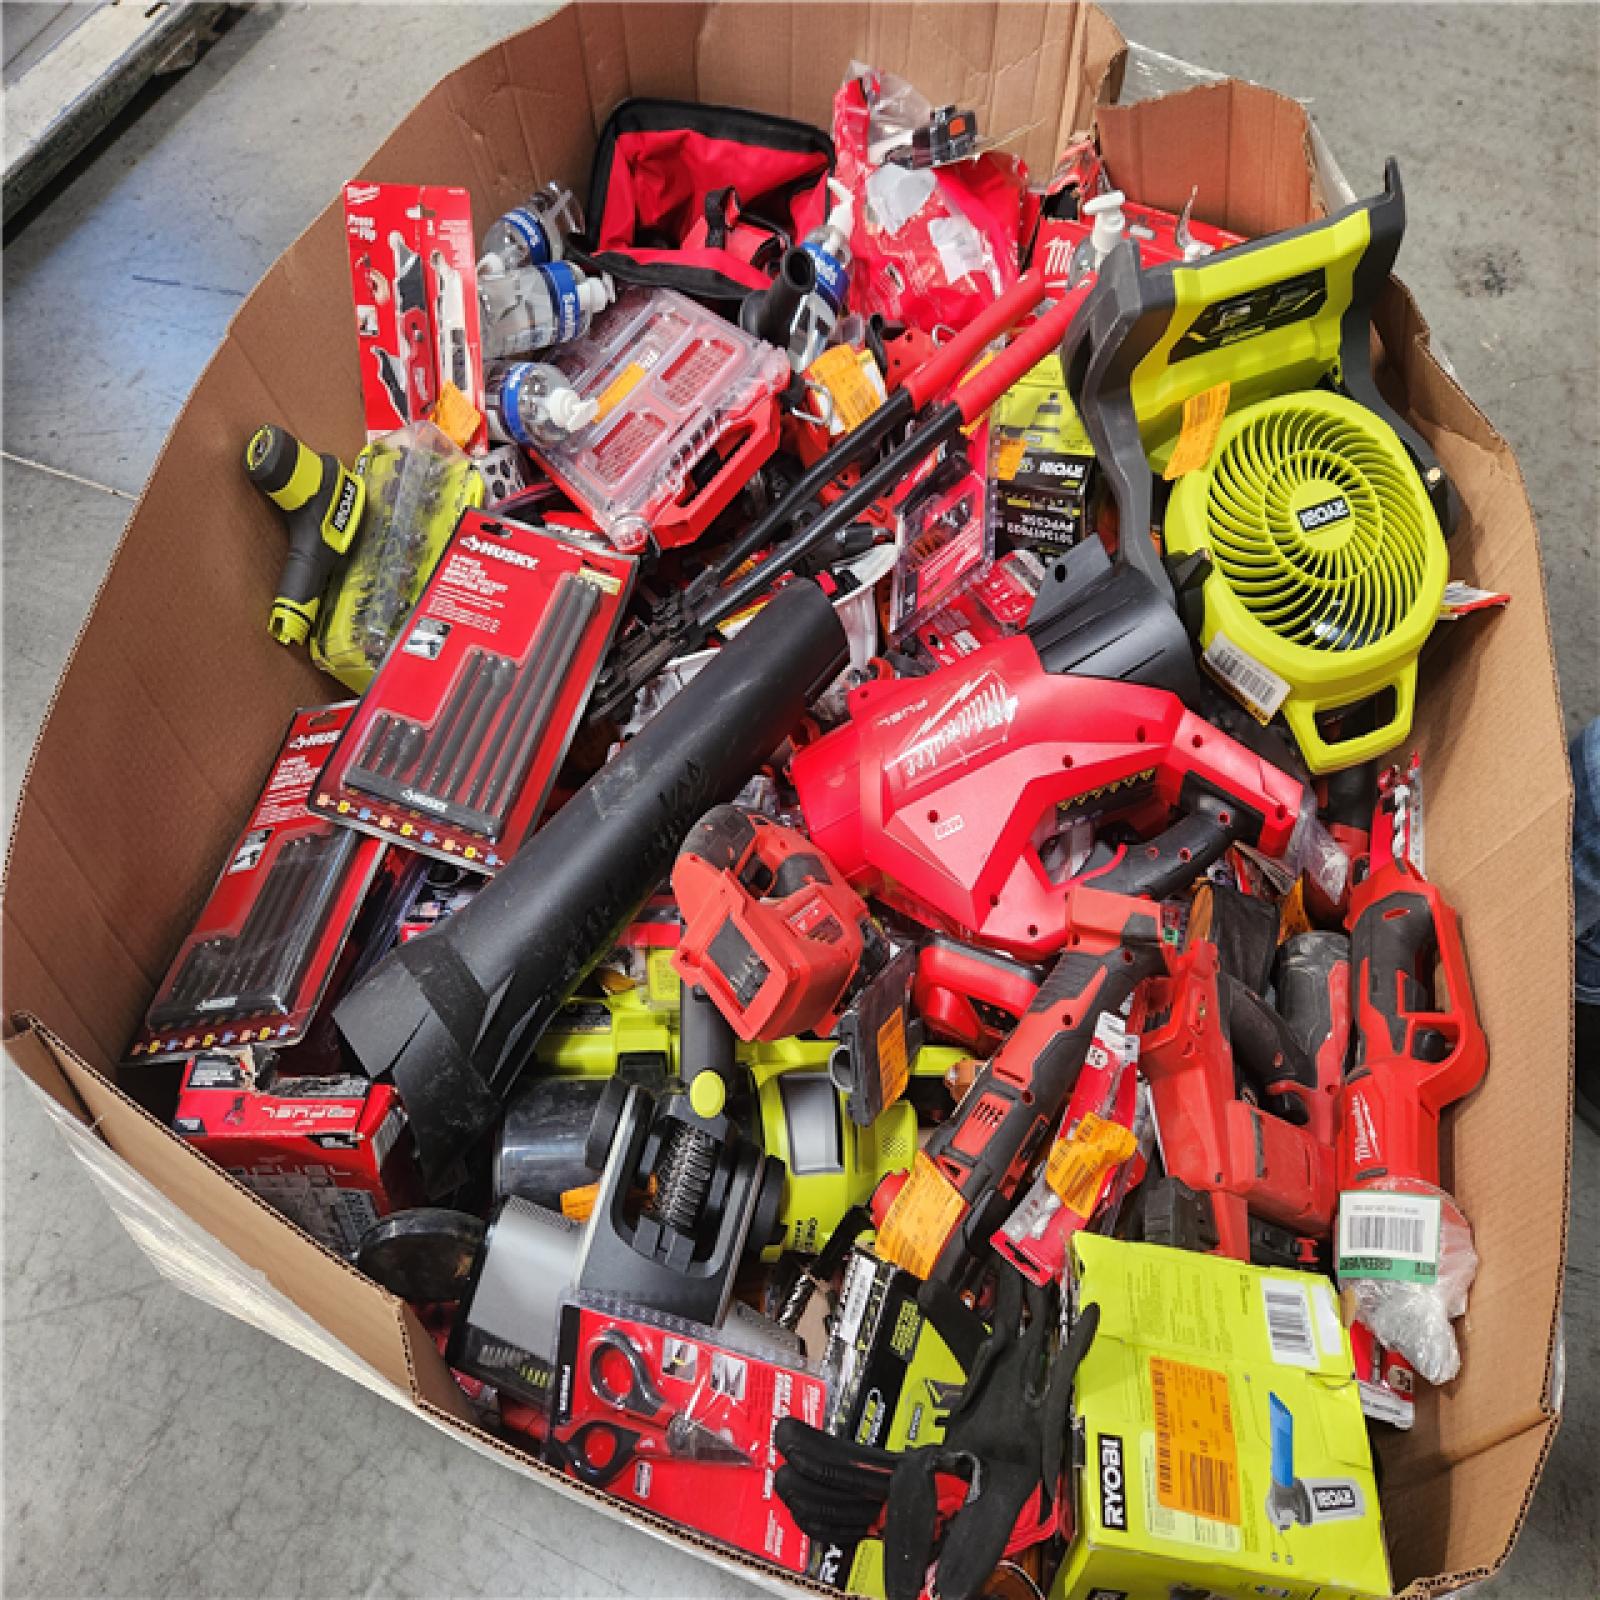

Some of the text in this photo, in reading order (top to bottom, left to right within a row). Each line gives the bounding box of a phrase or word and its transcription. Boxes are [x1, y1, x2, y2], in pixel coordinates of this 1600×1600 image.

[1040, 461, 1085, 479] RYOBI
[336, 483, 357, 531] RYOBI
[1303, 500, 1346, 528] RYOBI
[479, 541, 541, 572] HUSKY
[877, 698, 929, 727] FUEL
[884, 683, 1019, 778] Milwaukee
[1351, 1094, 1374, 1165] Milwaukee
[1103, 1438, 1125, 1527] RYOBI
[1317, 1489, 1352, 1506] RYOBI
